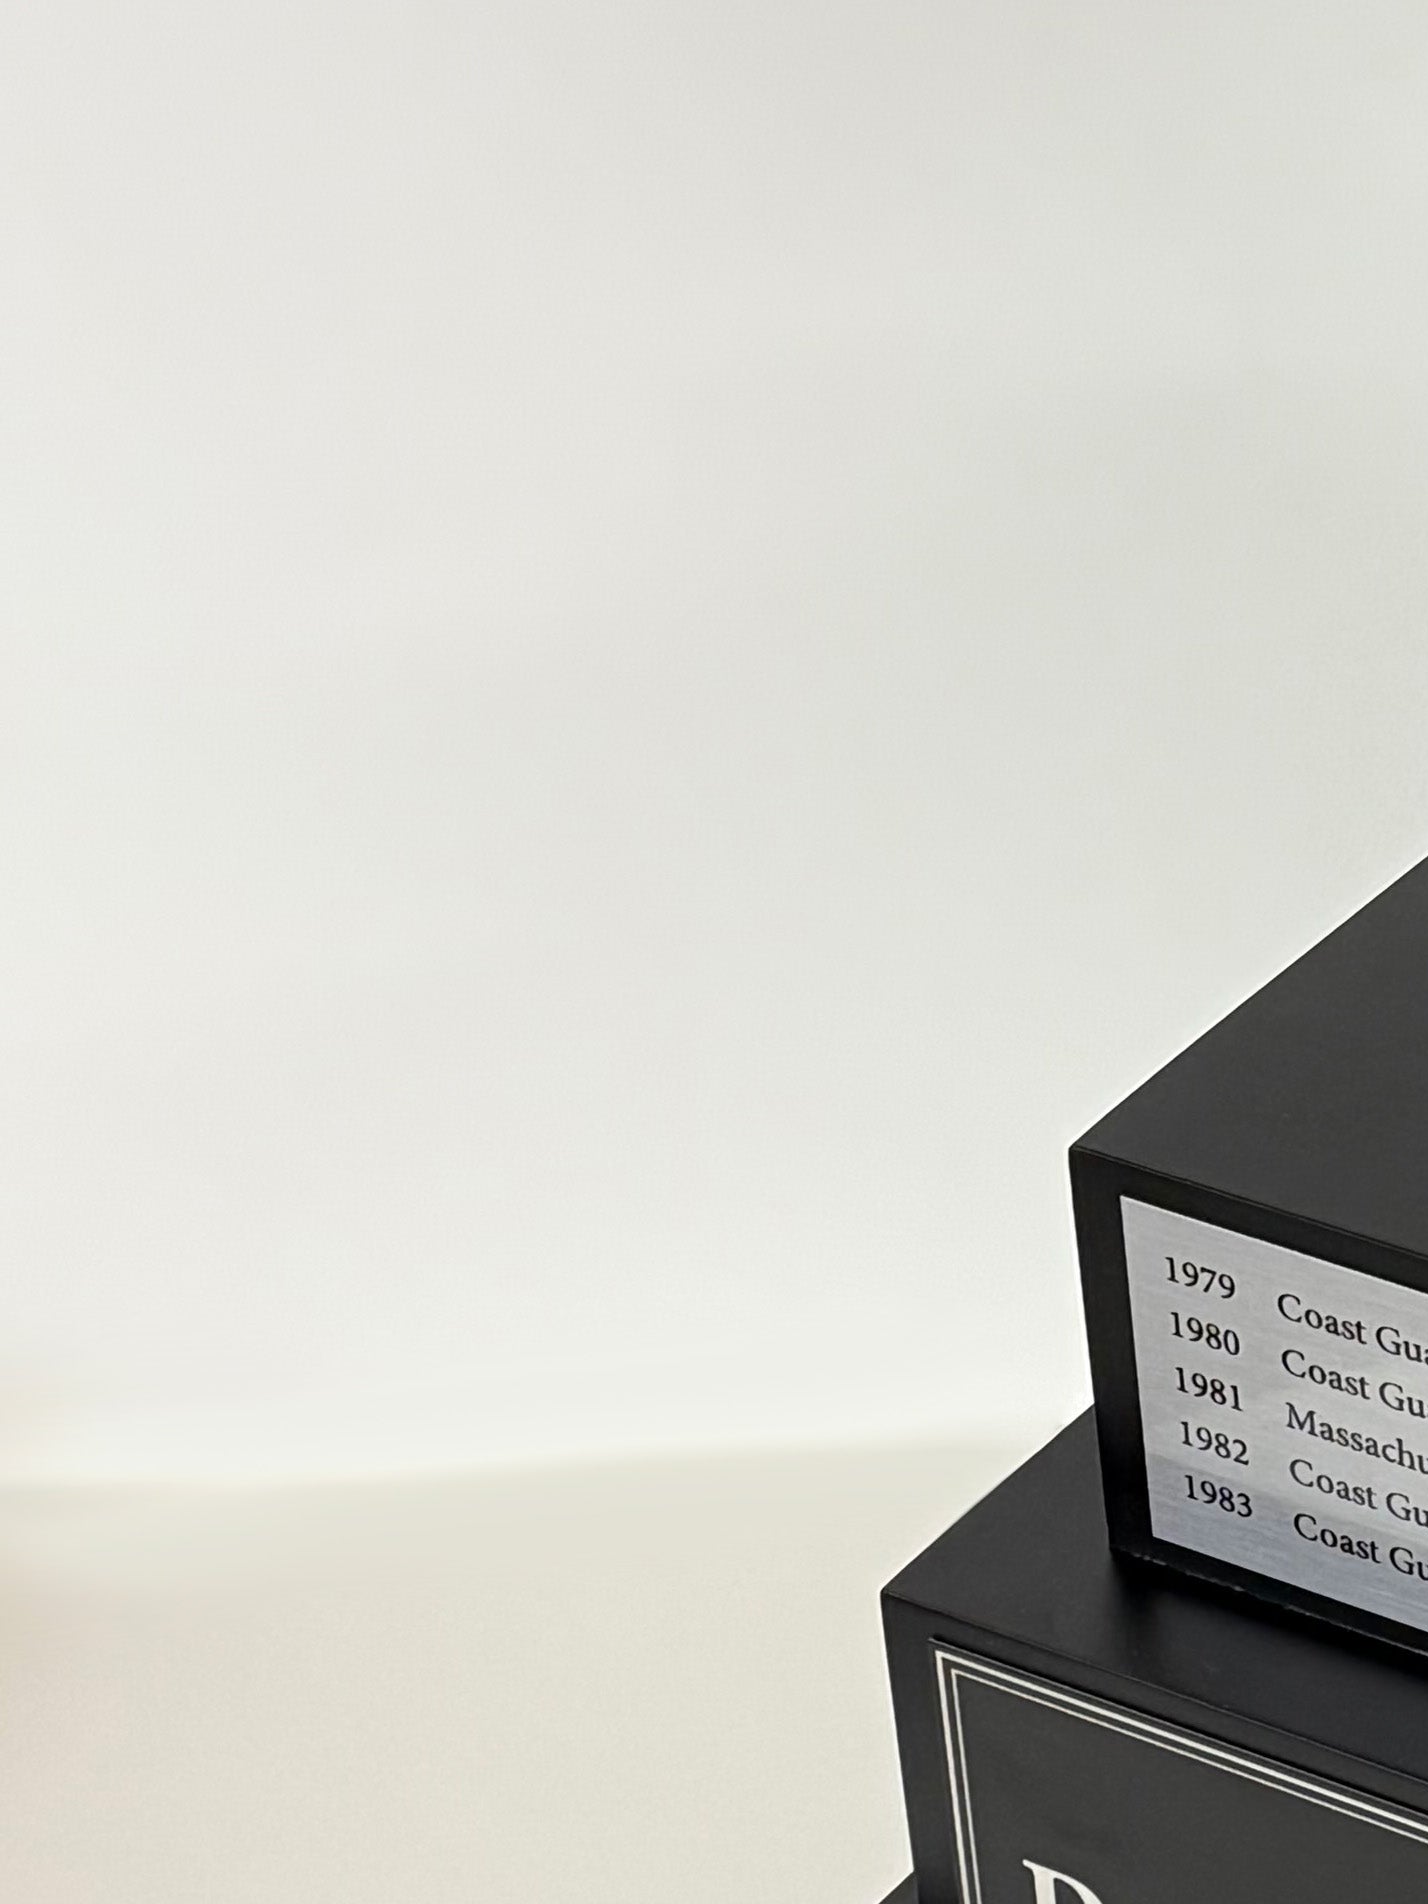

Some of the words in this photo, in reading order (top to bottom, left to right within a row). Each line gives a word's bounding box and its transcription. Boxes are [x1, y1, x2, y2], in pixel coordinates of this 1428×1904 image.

[1163, 1255, 1236, 1300] 1979
[1276, 1292, 1368, 1346] Coast
[1169, 1310, 1241, 1356] 1980
[1279, 1347, 1371, 1401] Coast
[1173, 1365, 1244, 1412] 1981
[1179, 1419, 1250, 1466] 1982
[1287, 1457, 1378, 1510] Coast
[1182, 1473, 1253, 1518] 1983
[1292, 1511, 1382, 1565] Coast
